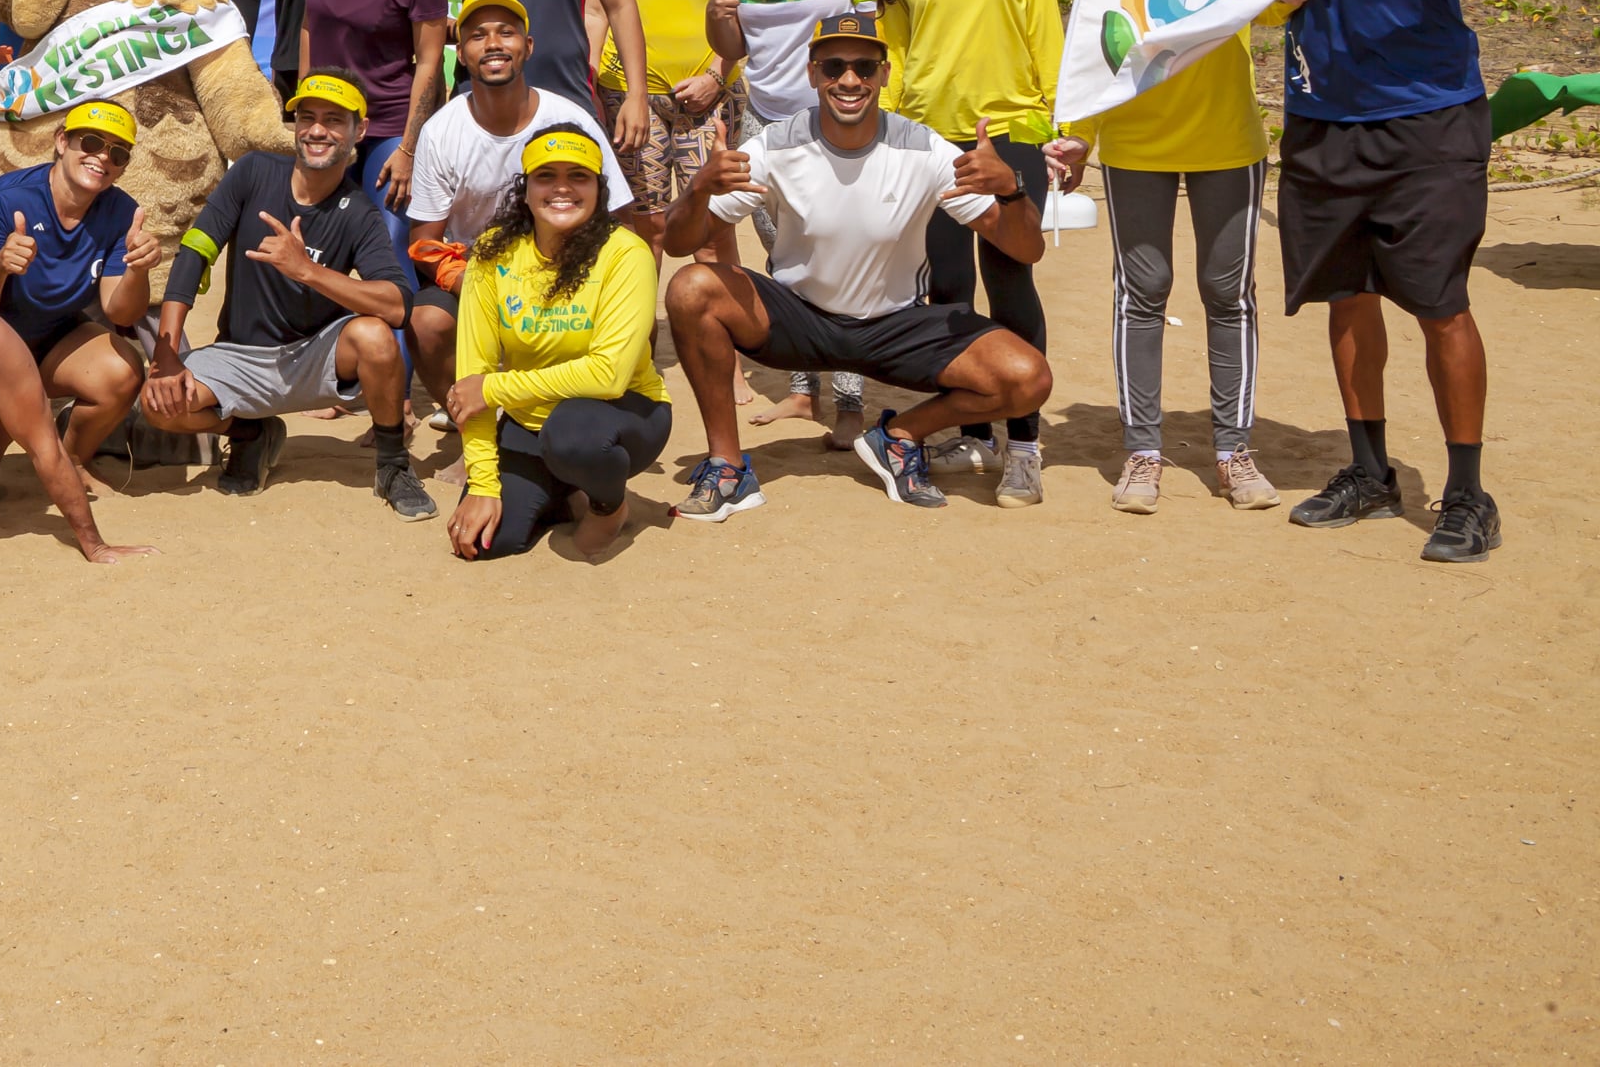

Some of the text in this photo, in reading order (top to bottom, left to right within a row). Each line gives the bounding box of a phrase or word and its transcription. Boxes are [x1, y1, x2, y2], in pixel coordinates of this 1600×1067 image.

[34, 18, 214, 112] RESTINGA
[571, 304, 588, 315] DA
[520, 317, 595, 334] RESTINGA
